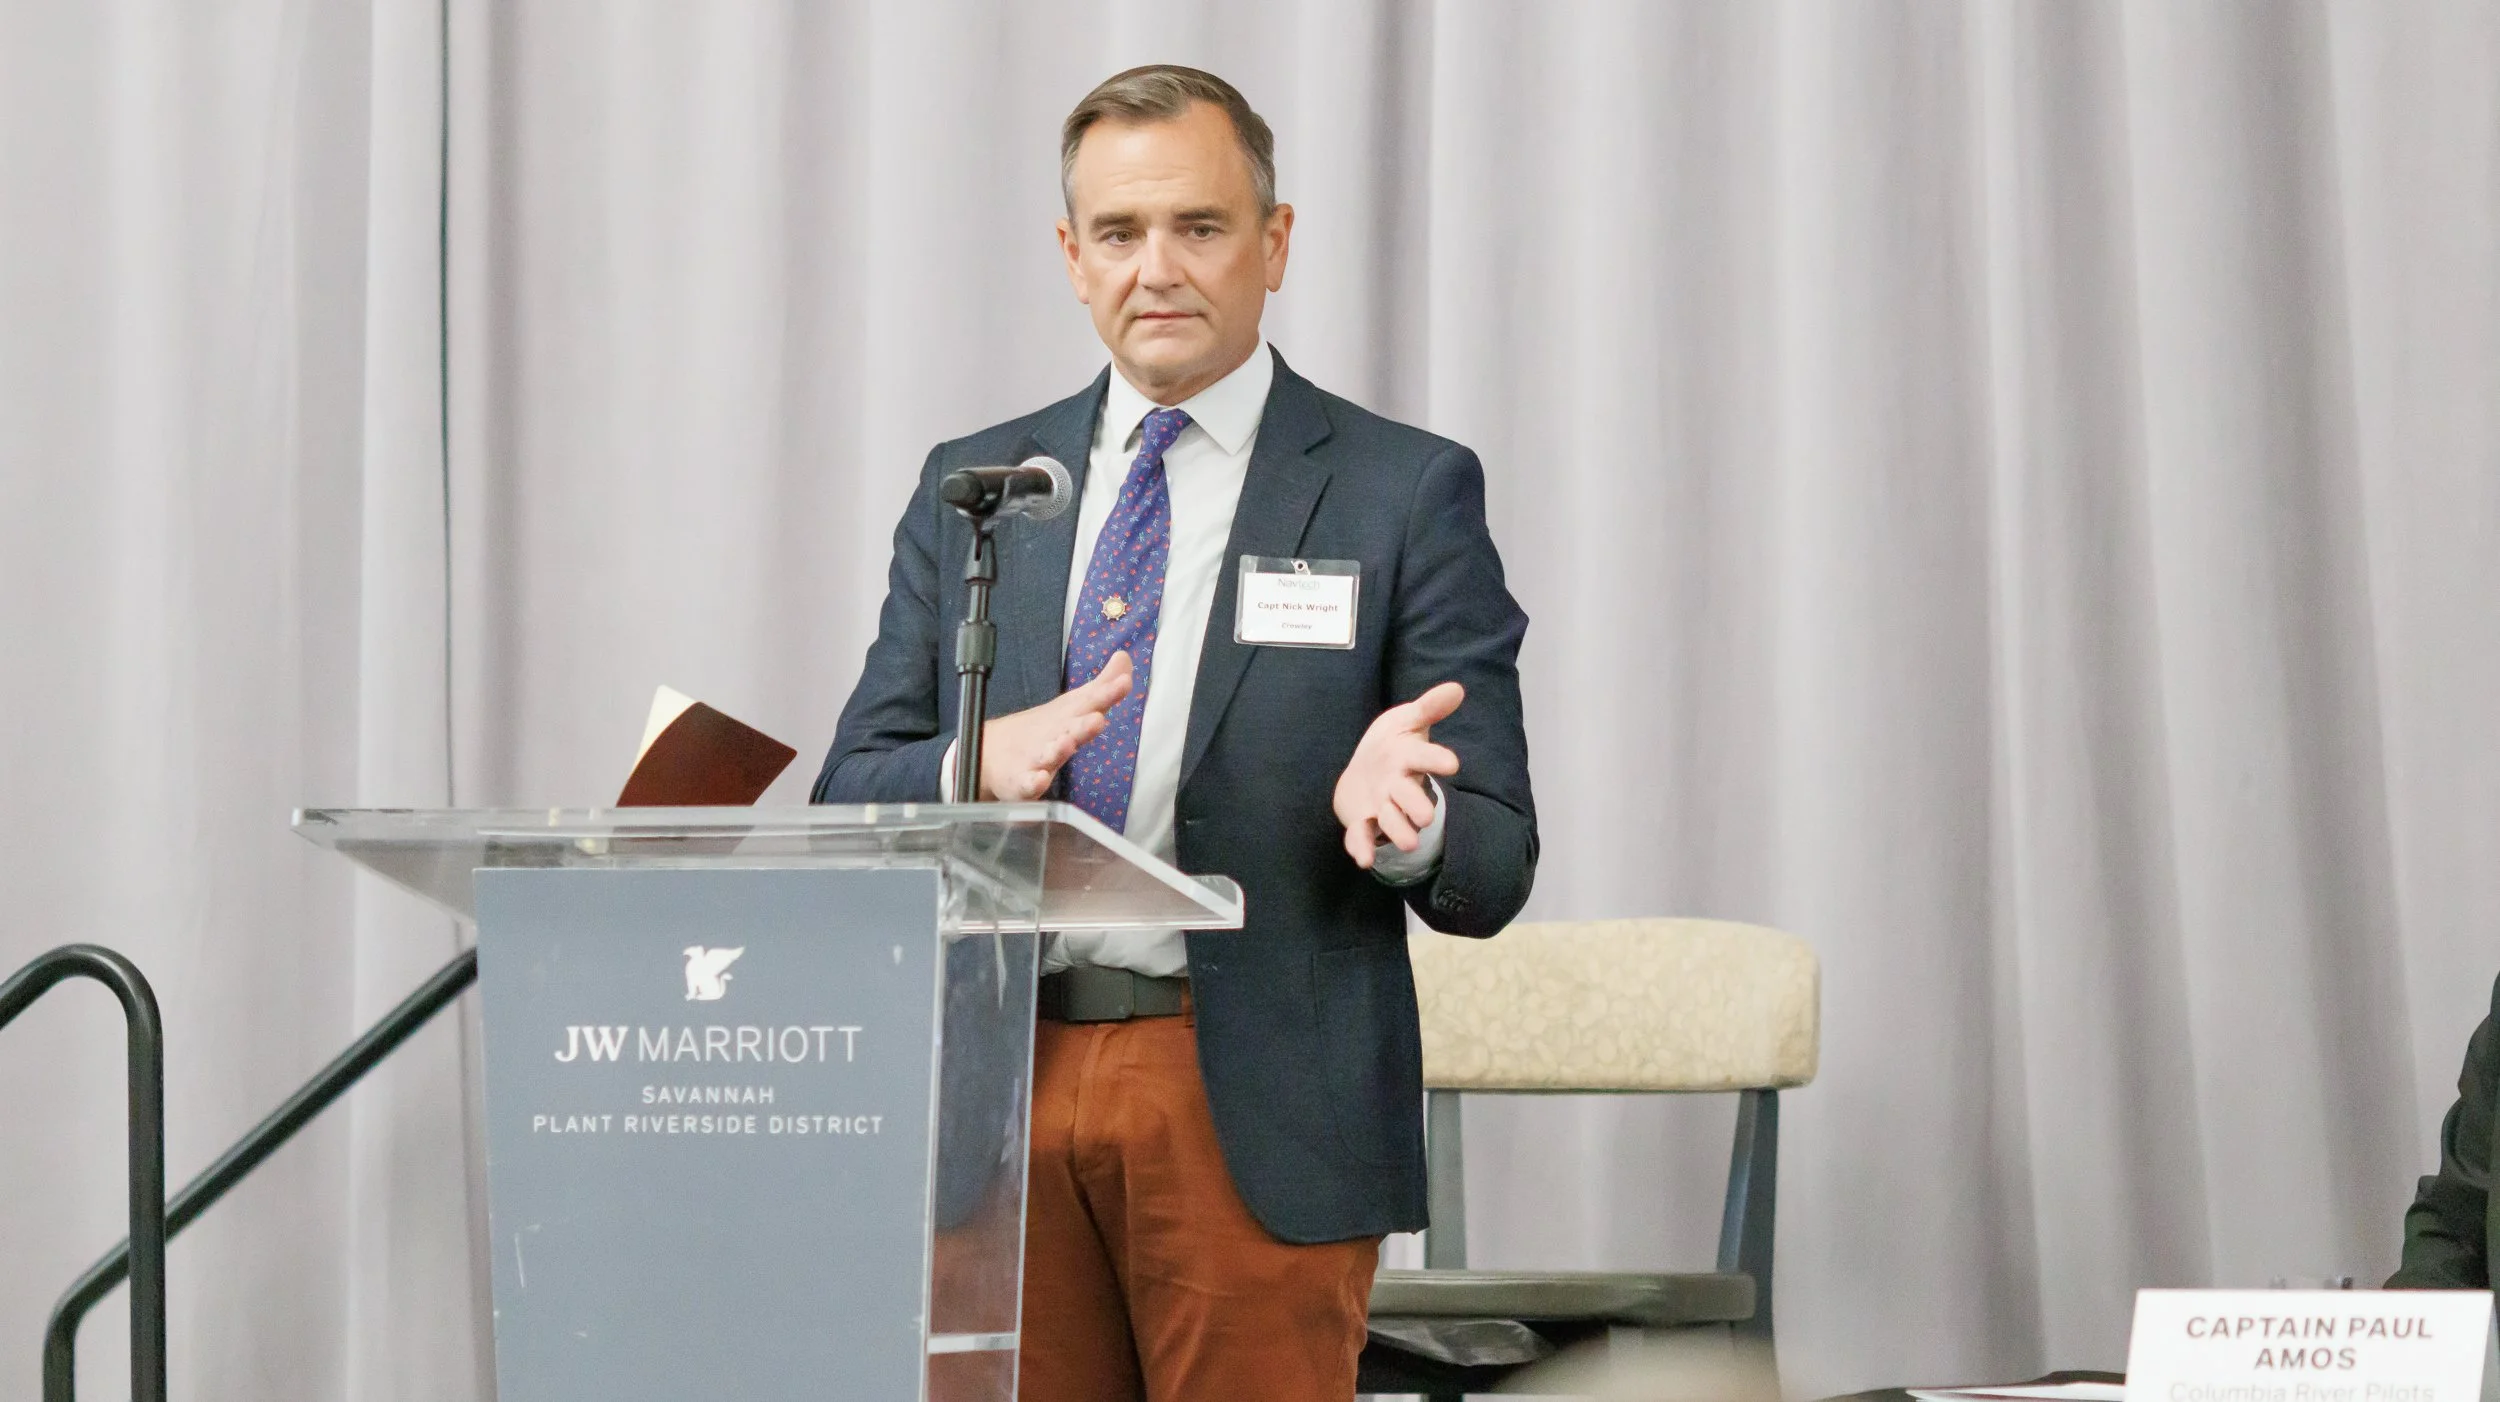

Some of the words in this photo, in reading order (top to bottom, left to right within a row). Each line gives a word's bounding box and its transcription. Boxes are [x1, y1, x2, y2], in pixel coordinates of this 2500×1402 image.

[1257, 601, 1279, 611] Capt
[1282, 602, 1303, 611] Nick
[1306, 603, 1339, 613] Wright
[1281, 622, 1313, 630] Crowley
[554, 1025, 629, 1063] JW
[637, 1025, 864, 1063] MARRIOTT
[641, 1085, 775, 1104] SAVANNAH
[533, 1115, 614, 1134] PLANT
[624, 1115, 757, 1134] RIVERSIDE
[769, 1115, 884, 1135] DISTRICT
[2185, 1316, 2336, 1339] CAPTAIN
[2348, 1316, 2435, 1339] PAUL
[2254, 1347, 2358, 1370] AMOS
[2168, 1381, 2288, 1402] Columbia
[2294, 1382, 2358, 1402] River
[2365, 1382, 2436, 1402] Pilots
